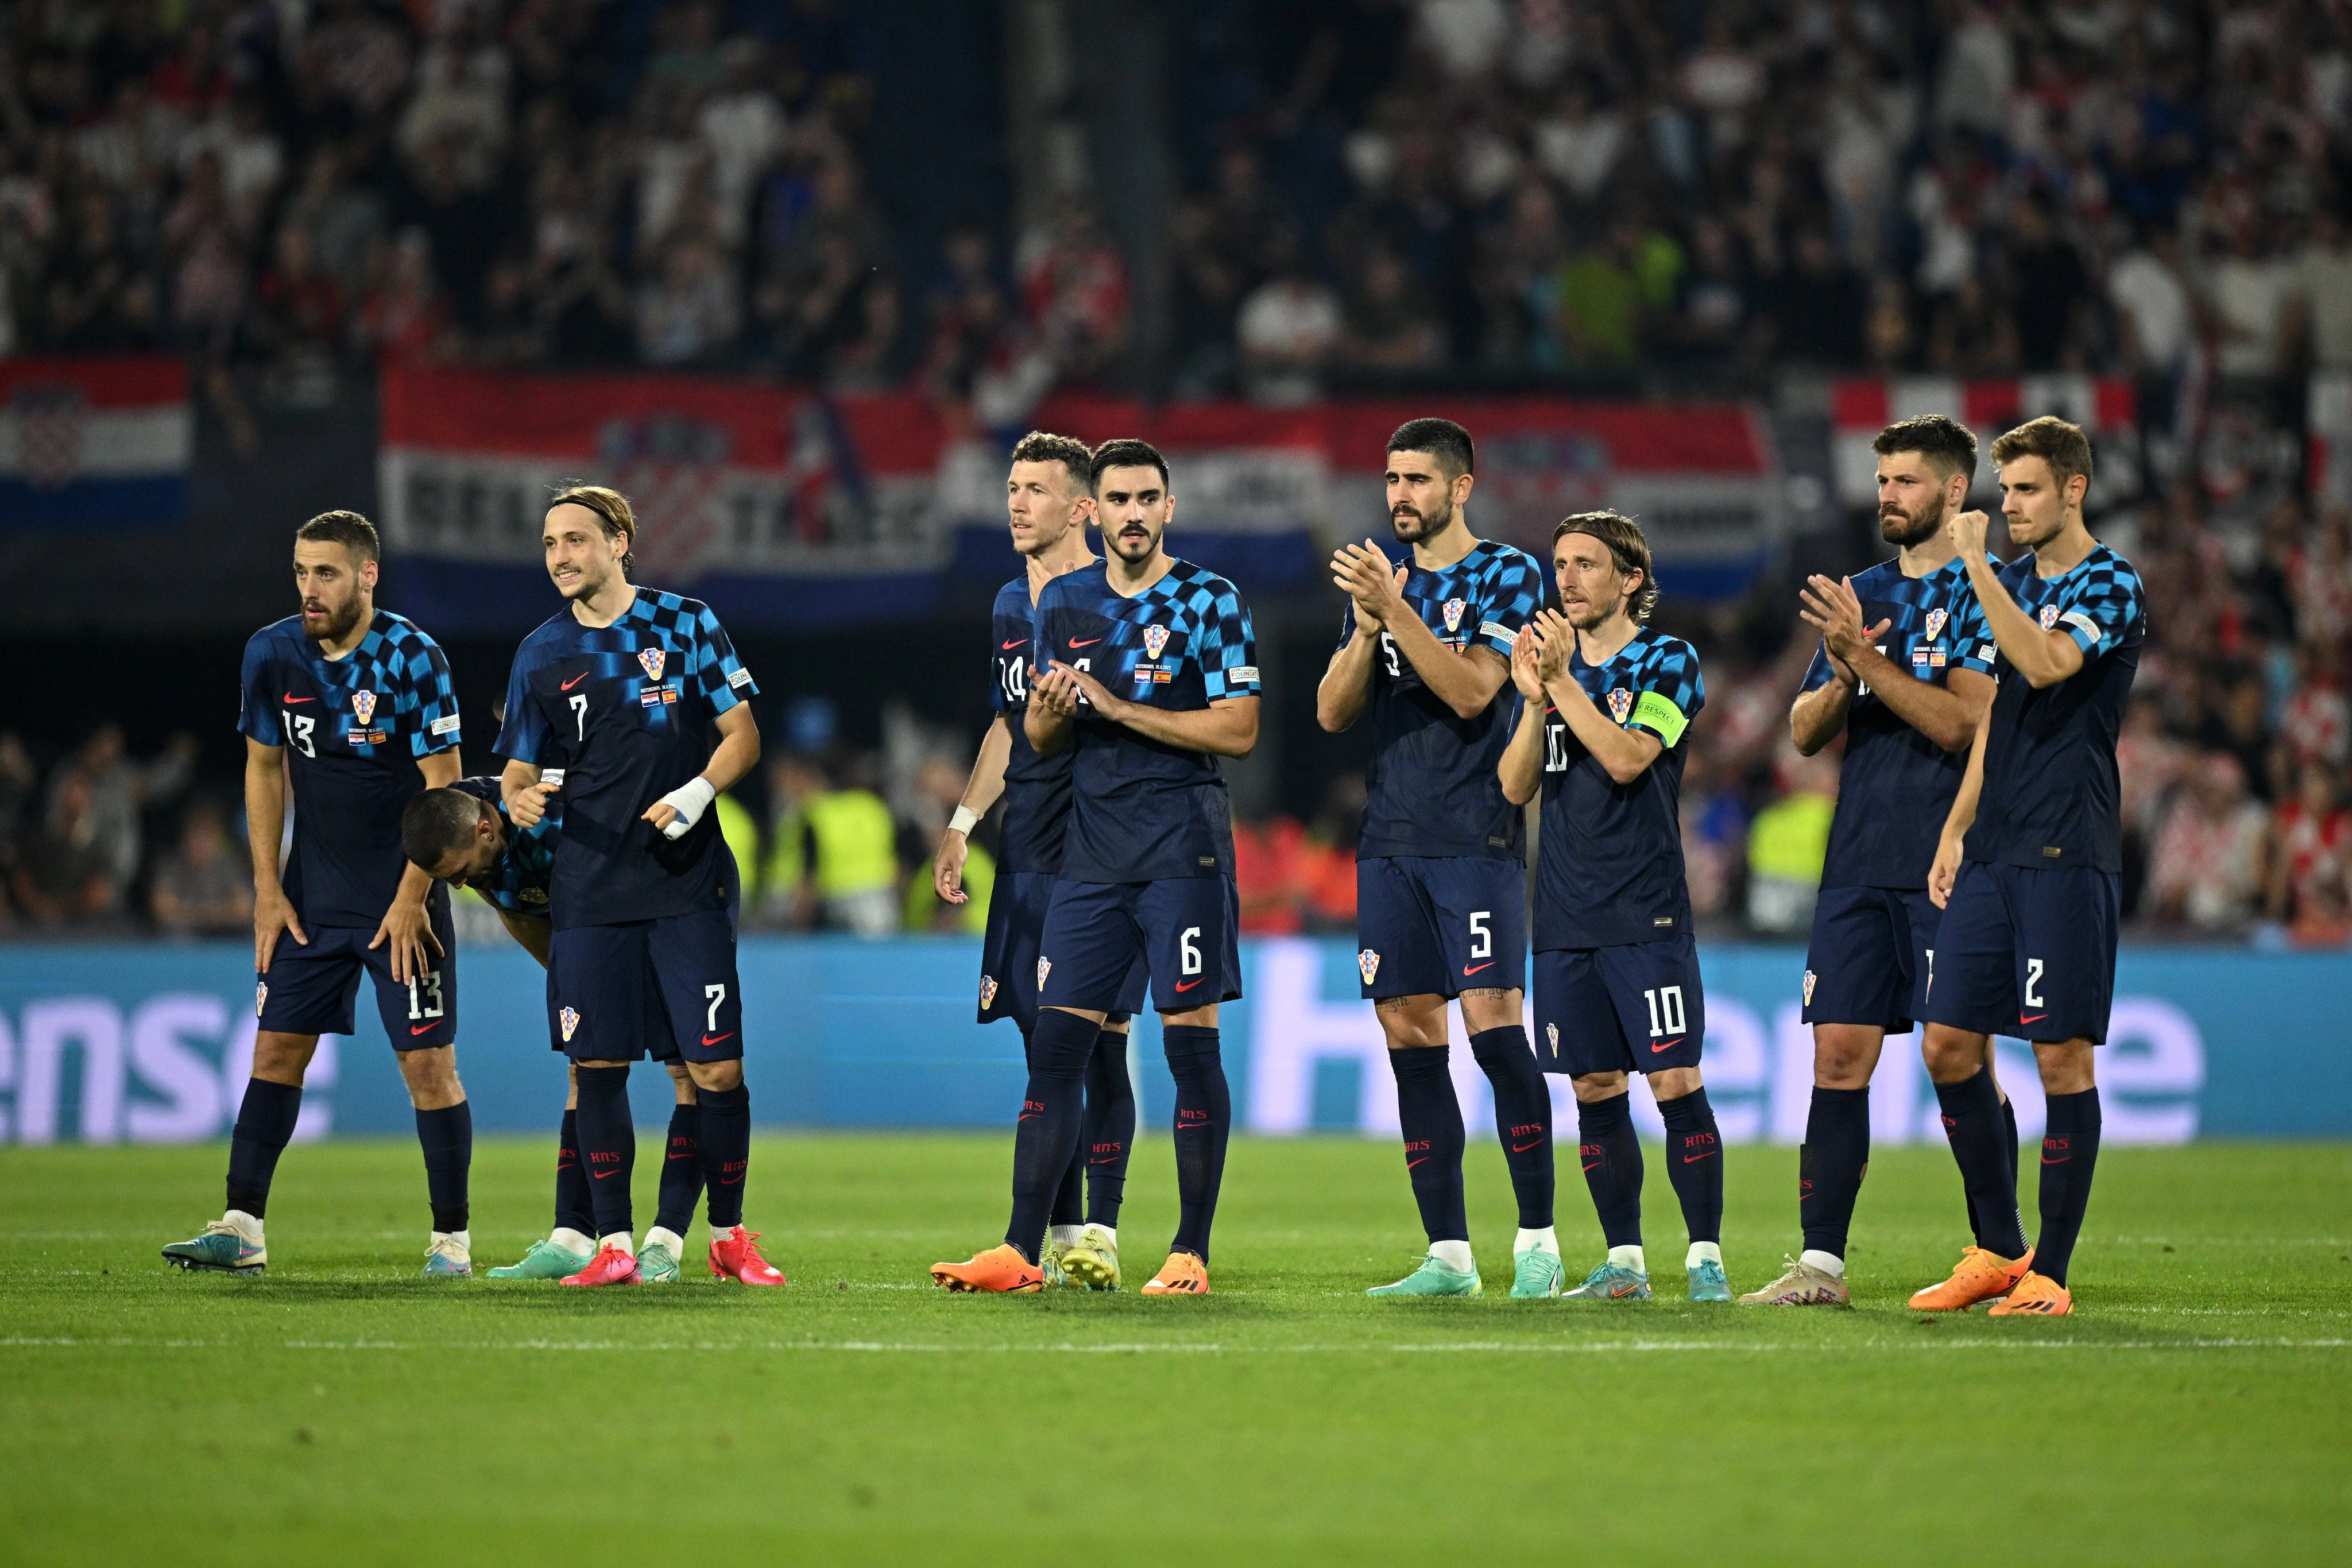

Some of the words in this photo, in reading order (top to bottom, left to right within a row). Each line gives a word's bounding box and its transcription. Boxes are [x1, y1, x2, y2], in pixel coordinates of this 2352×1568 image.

[1482, 625, 1517, 642] FOUNDATIO
[1381, 632, 1401, 676] 5
[999, 656, 1026, 701] 14
[568, 694, 588, 742] 7
[1644, 704, 1675, 725] RESPECT
[283, 709, 316, 758] 13
[1545, 725, 1568, 772] 10
[1470, 911, 1491, 958] 5
[1181, 927, 1202, 975] 6
[408, 971, 444, 1019] 13
[2025, 958, 2043, 1008] 2
[705, 984, 725, 1031] 7
[1644, 985, 1686, 1037] 10
[1181, 1109, 1206, 1119] HNS
[1510, 1122, 1542, 1137] HNS
[1941, 1116, 1957, 1126] NS
[1093, 1142, 1121, 1152] HNS
[1405, 1140, 1431, 1152] HNS
[1685, 1133, 1715, 1148] HNS
[2043, 1136, 2069, 1150] HNS
[590, 1151, 620, 1163] HNS
[723, 1157, 748, 1172] HNS
